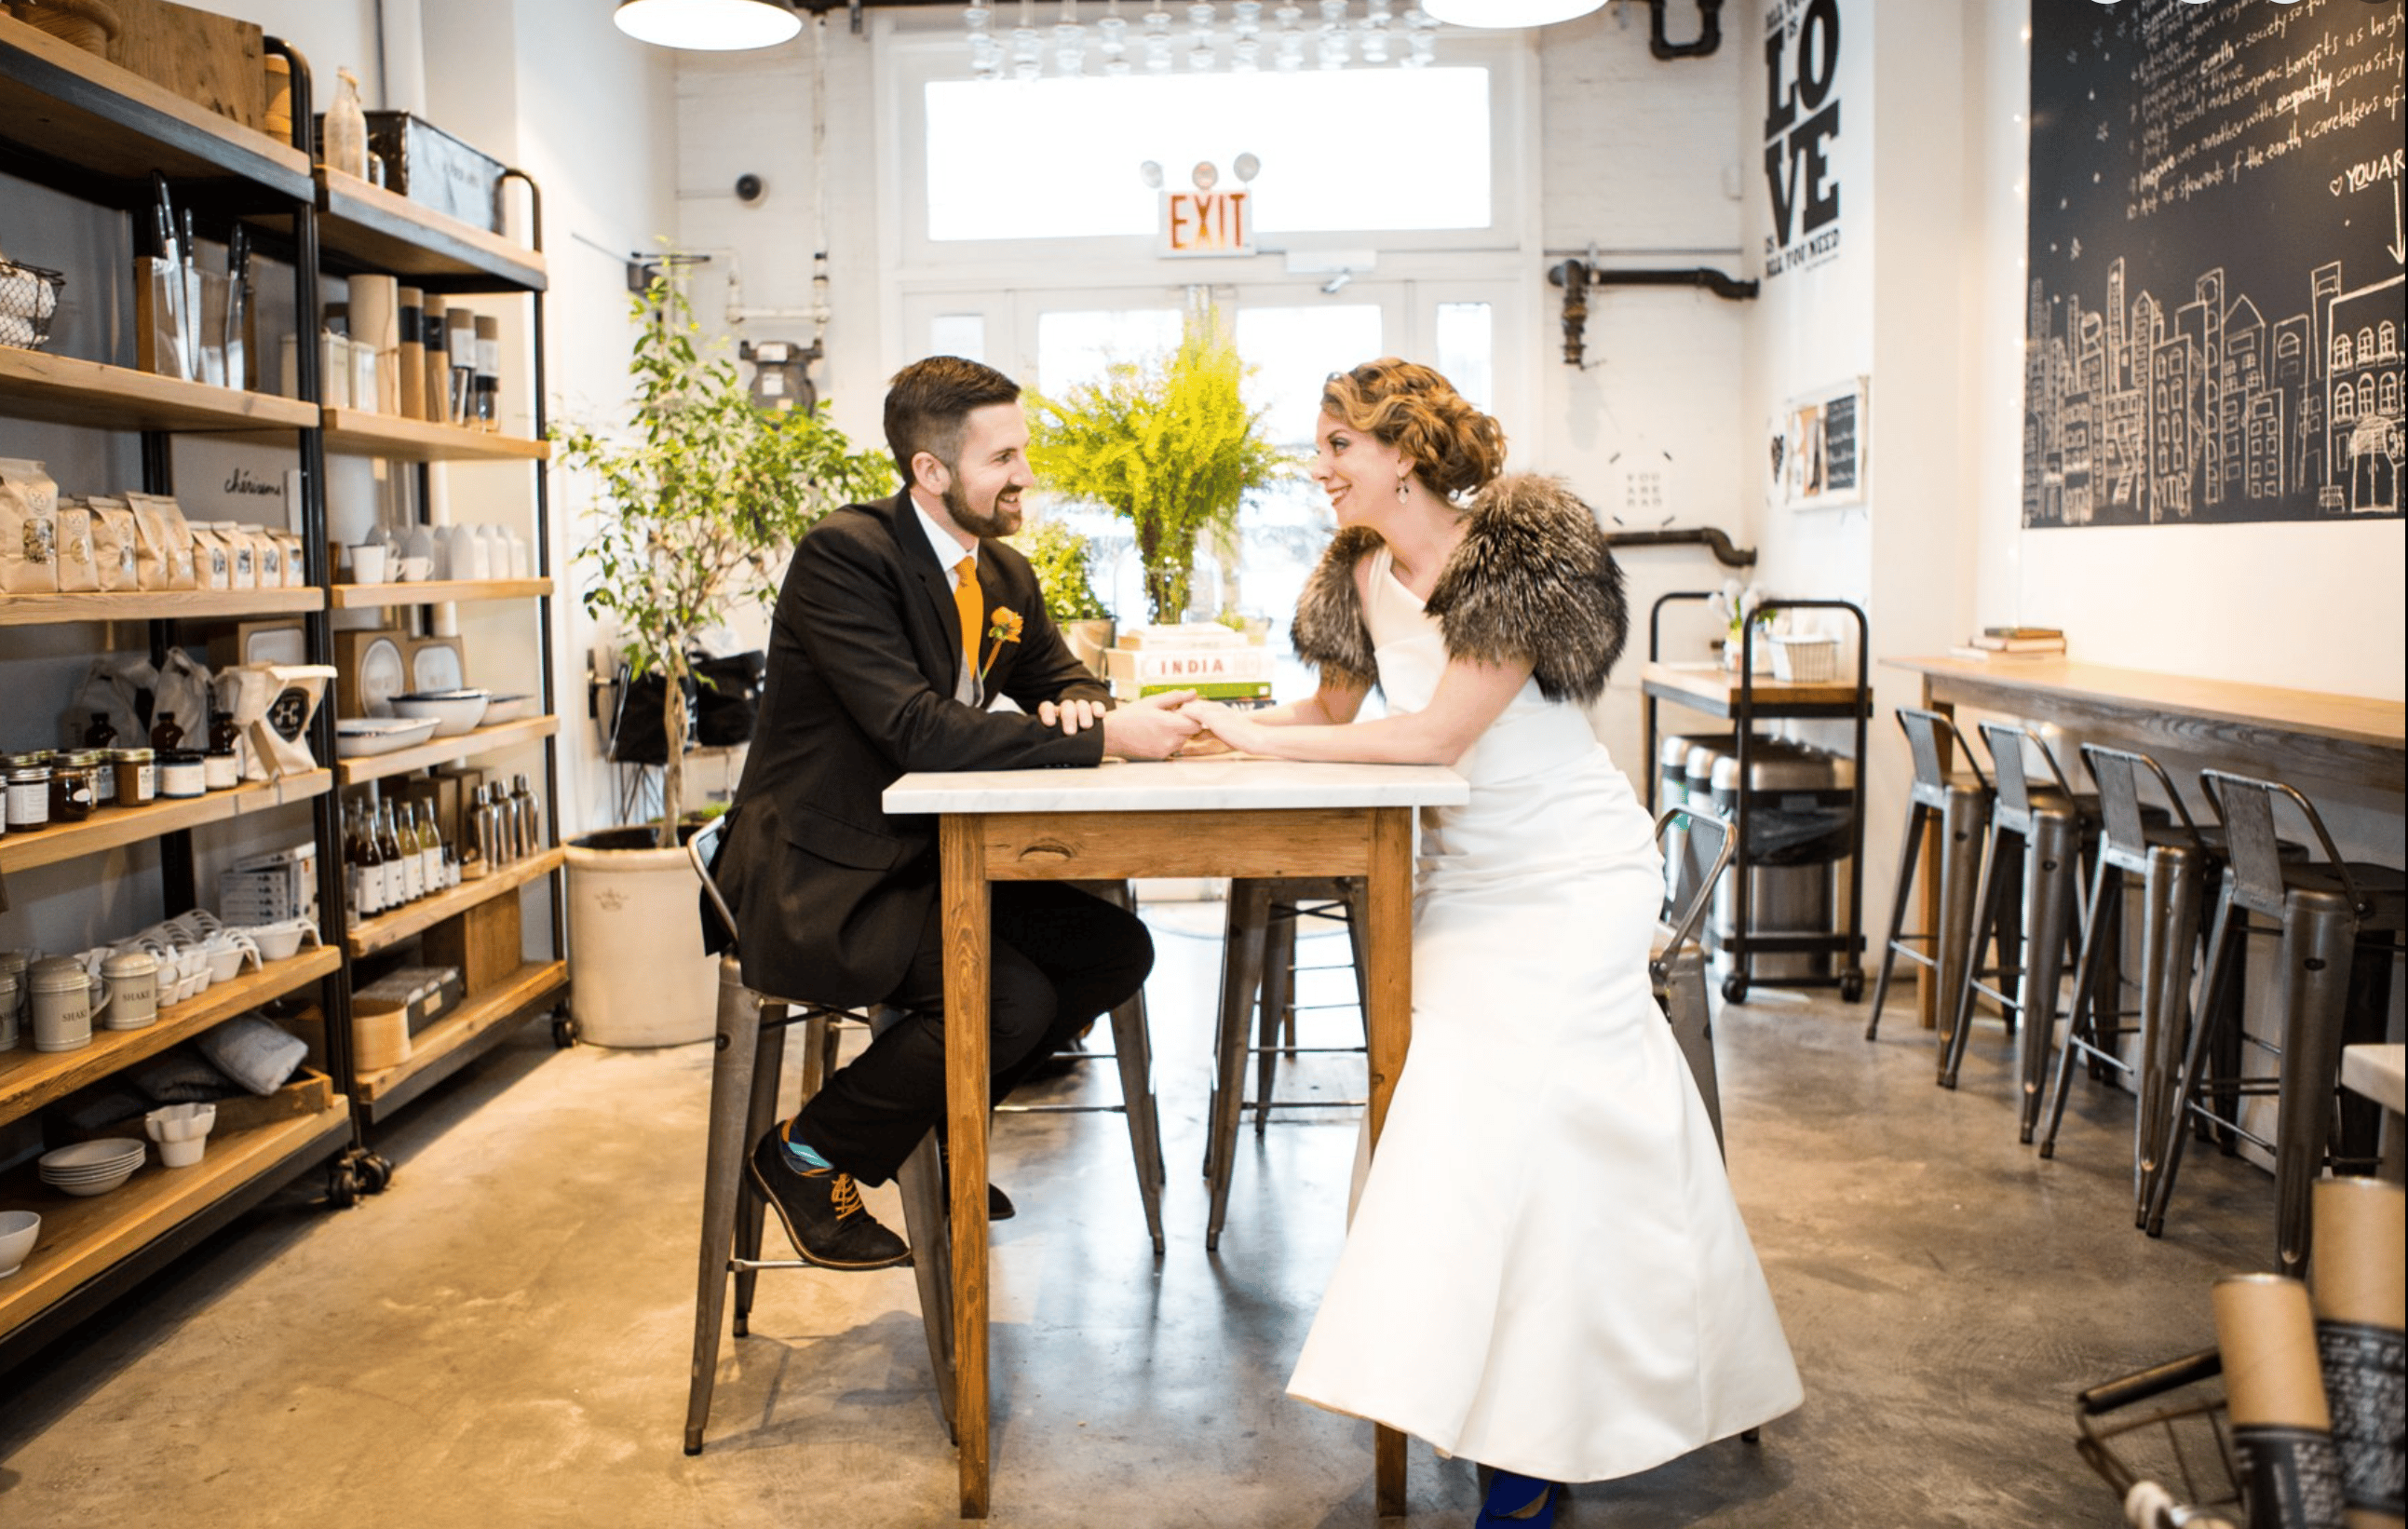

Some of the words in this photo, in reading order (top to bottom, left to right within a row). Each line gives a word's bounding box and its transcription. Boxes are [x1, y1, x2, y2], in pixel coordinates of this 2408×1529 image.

[2200, 39, 2234, 74] earth
[2245, 13, 2287, 47] society
[2209, 88, 2230, 109] and
[2286, 31, 2339, 79] benefits
[2346, 27, 2364, 47] as
[2371, 2, 2405, 38] high
[2200, 119, 2244, 150] another
[2246, 100, 2273, 129] with
[2336, 42, 2405, 88] curiosity
[2244, 145, 2265, 170] the
[2266, 119, 2302, 160] earth
[2311, 95, 2379, 139] caretakers
[2384, 84, 2401, 122] of
[1170, 193, 1249, 250] EXIT
[1786, 244, 1806, 270] YOU
[1809, 228, 1841, 259] NEED
[1161, 657, 1225, 675] INDIA
